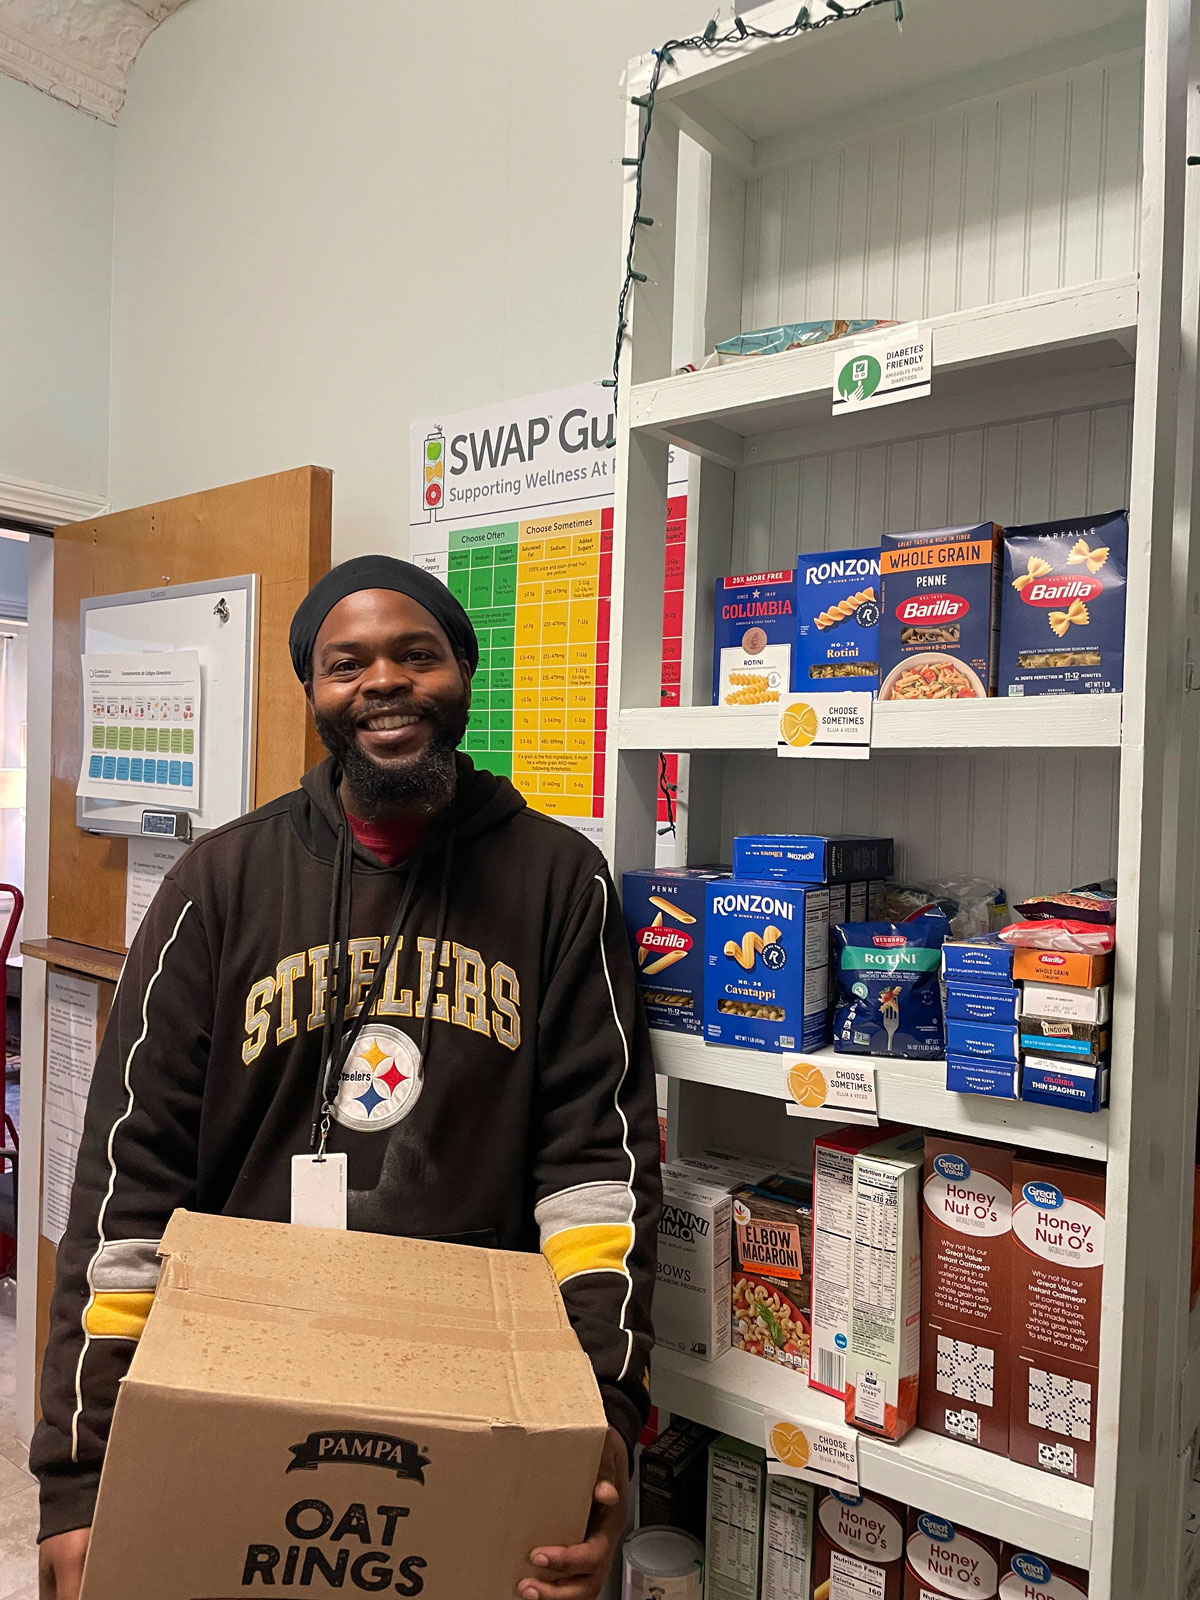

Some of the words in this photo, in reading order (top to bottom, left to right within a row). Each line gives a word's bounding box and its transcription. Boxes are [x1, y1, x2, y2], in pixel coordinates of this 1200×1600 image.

[886, 344, 924, 360] DIABETES
[886, 354, 924, 370] FRIENDLY
[449, 417, 550, 476] SWAP
[449, 480, 522, 503] Supporting
[525, 461, 588, 488] Wellness
[590, 460, 608, 478] At
[526, 525, 551, 535] Choose
[553, 518, 593, 530] Sometimes
[1037, 527, 1097, 541] FARFALLE
[461, 533, 486, 544] Choose
[487, 531, 505, 541] Often
[897, 540, 912, 548] GREAT
[889, 549, 934, 569] WHOLE
[938, 544, 980, 563] GRAIN
[745, 574, 766, 582] MORE
[766, 572, 783, 580] FREE
[916, 574, 947, 588] PENNE
[1029, 581, 1092, 601] Barilla
[722, 600, 793, 620] COLUMBIA
[862, 608, 873, 622] R
[903, 599, 960, 619] Barilla
[826, 647, 859, 658] Rotini
[1064, 671, 1080, 680] 11-12
[828, 706, 859, 715] CHOOSE
[821, 716, 865, 725] SOMETIMES
[786, 850, 815, 861] RONZONI
[651, 885, 678, 894] PENNE
[713, 894, 793, 921] RONZONI
[641, 931, 686, 948] Barilla
[768, 950, 779, 965] R
[864, 952, 916, 966] ROTINI
[1041, 955, 1065, 964] Barilla
[1035, 967, 1053, 975] WHOLE
[724, 983, 776, 1001] Cavatappi
[242, 935, 521, 1066] STEELERS
[835, 1070, 865, 1082] CHOOSE
[1043, 1076, 1075, 1087] COLUMBIA
[830, 1079, 873, 1092] SOMETIMES
[1031, 1081, 1048, 1090] THIN
[1048, 1085, 1086, 1097] SPAGHETTI
[818, 1150, 840, 1159] Nutrition
[818, 1168, 836, 1177] Calories
[938, 1158, 964, 1172] Great
[944, 1167, 964, 1177] Value
[858, 1167, 882, 1178] Nutrition
[882, 1172, 898, 1181] Facts
[857, 1191, 872, 1200] Calories
[872, 1194, 884, 1203] 210
[946, 1183, 996, 1208] Honey
[1027, 1185, 1057, 1200] Great
[1034, 1194, 1057, 1206] Value
[944, 1199, 970, 1216] Nut
[973, 1206, 998, 1222] O's
[1037, 1211, 1092, 1238] Honey
[745, 1225, 791, 1249] ELBOW
[940, 1239, 955, 1249] Why
[1035, 1227, 1064, 1246] Nut
[1067, 1235, 1094, 1253] O's
[742, 1241, 799, 1268] MACARONI
[937, 1253, 958, 1264] Instant
[945, 1248, 963, 1257] Great
[963, 1252, 983, 1263] Value
[1031, 1269, 1047, 1279] Why
[1047, 1274, 1060, 1282] not
[1061, 1276, 1071, 1286] try
[680, 1281, 707, 1294] PRODUCT
[1028, 1284, 1051, 1295] Instant
[1051, 1290, 1087, 1304] Oatmeal?
[1036, 1278, 1057, 1289] Great
[1057, 1284, 1078, 1295] Value
[1028, 1301, 1052, 1312] variety
[1041, 1296, 1065, 1308] comes
[1065, 1301, 1073, 1309] in
[1028, 1316, 1050, 1326] whole
[1050, 1322, 1069, 1332] grain
[1069, 1328, 1086, 1337] oats
[1044, 1313, 1066, 1323] made
[1066, 1319, 1082, 1327] with
[1025, 1323, 1040, 1332] and
[1053, 1331, 1073, 1340] great
[1073, 1336, 1089, 1345] way
[1028, 1331, 1036, 1339] to
[1036, 1334, 1052, 1343] start
[1052, 1338, 1068, 1347] your
[860, 1382, 881, 1393] GUIDING
[862, 1388, 877, 1398] STARS
[318, 1437, 403, 1464] PAMPA
[818, 1435, 848, 1451] CHOOSE
[813, 1443, 855, 1463] SOMETIMES
[713, 1452, 740, 1466] Nutrition
[740, 1461, 757, 1472] Facts
[285, 1498, 411, 1547] OAT
[840, 1506, 886, 1535] Honey
[921, 1517, 949, 1534] Great
[838, 1521, 862, 1541] Nut
[865, 1532, 888, 1550] O's
[927, 1526, 949, 1539] Value
[833, 1553, 863, 1569] Nutrition
[863, 1565, 883, 1577] Facts
[929, 1542, 980, 1573] Honey
[241, 1544, 428, 1597] RINGS
[927, 1558, 954, 1578] Nut
[957, 1569, 982, 1588] O's
[1016, 1557, 1045, 1575] Great
[832, 1575, 856, 1588] Calories
[1021, 1567, 1045, 1582] Value
[868, 1587, 882, 1597] 160
